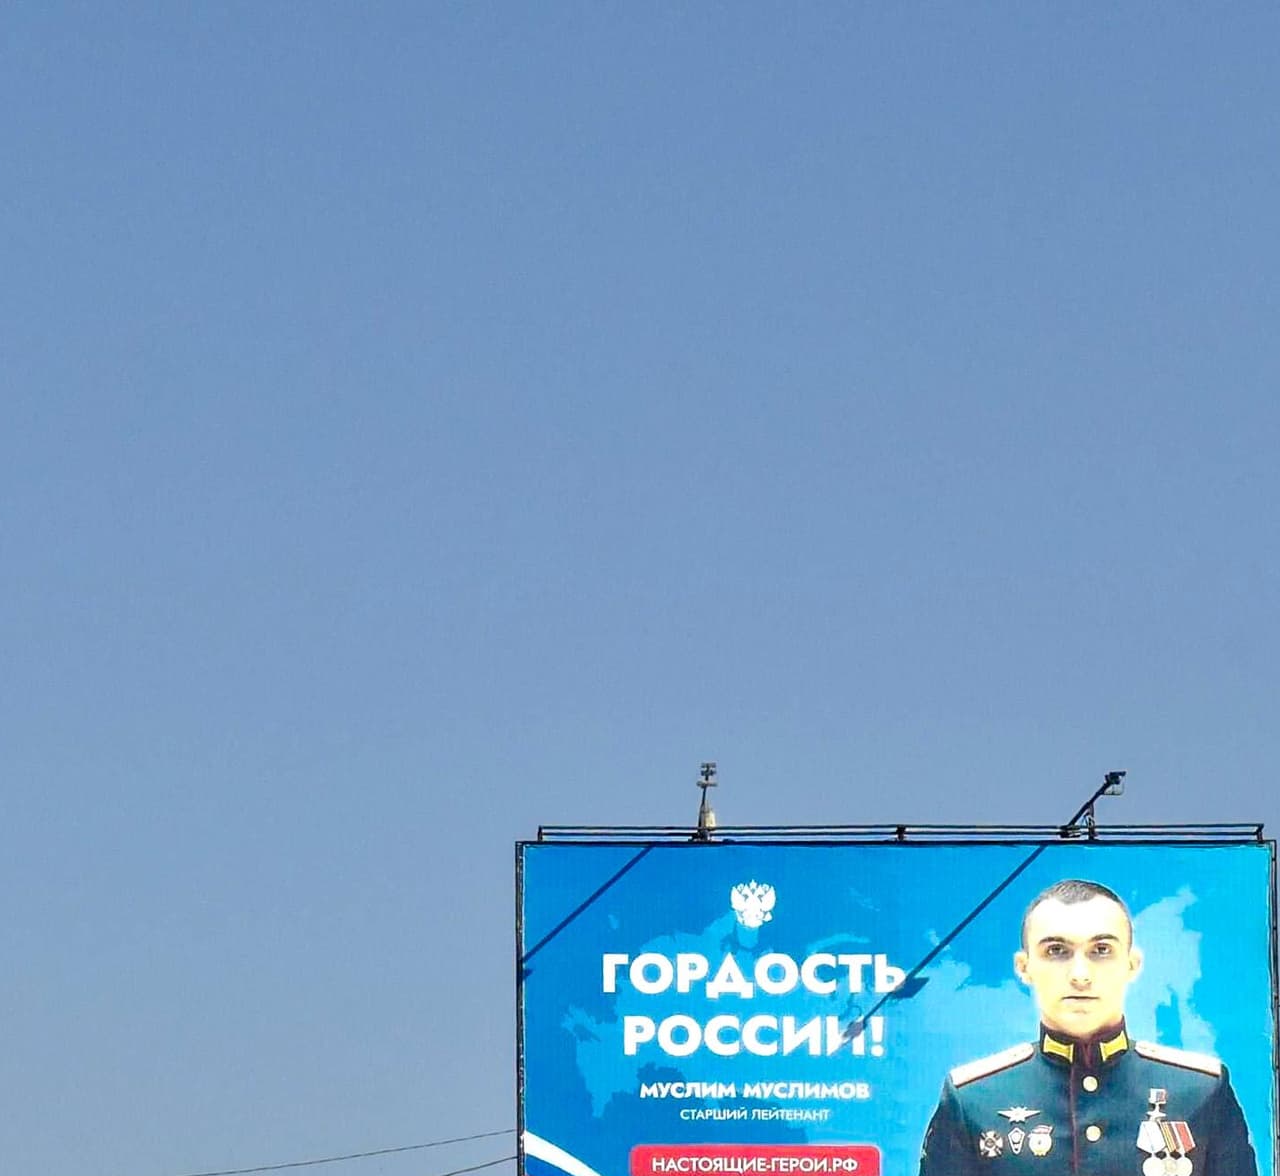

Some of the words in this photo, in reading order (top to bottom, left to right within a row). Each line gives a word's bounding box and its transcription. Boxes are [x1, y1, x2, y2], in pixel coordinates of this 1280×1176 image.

[602, 952, 907, 999] ГОРДОСТЬ
[623, 1014, 884, 1057] РОССИИ!
[639, 1082, 736, 1099] МУСЛИМ
[742, 1082, 870, 1099] МУСЛИМОВ
[679, 1107, 748, 1121] СТАРШИЙ
[751, 1107, 831, 1121] ЛЕЙТЕНАНТ
[651, 1157, 858, 1175] НАСТОЯЩИЕ-ГЕРОИ.РФ
